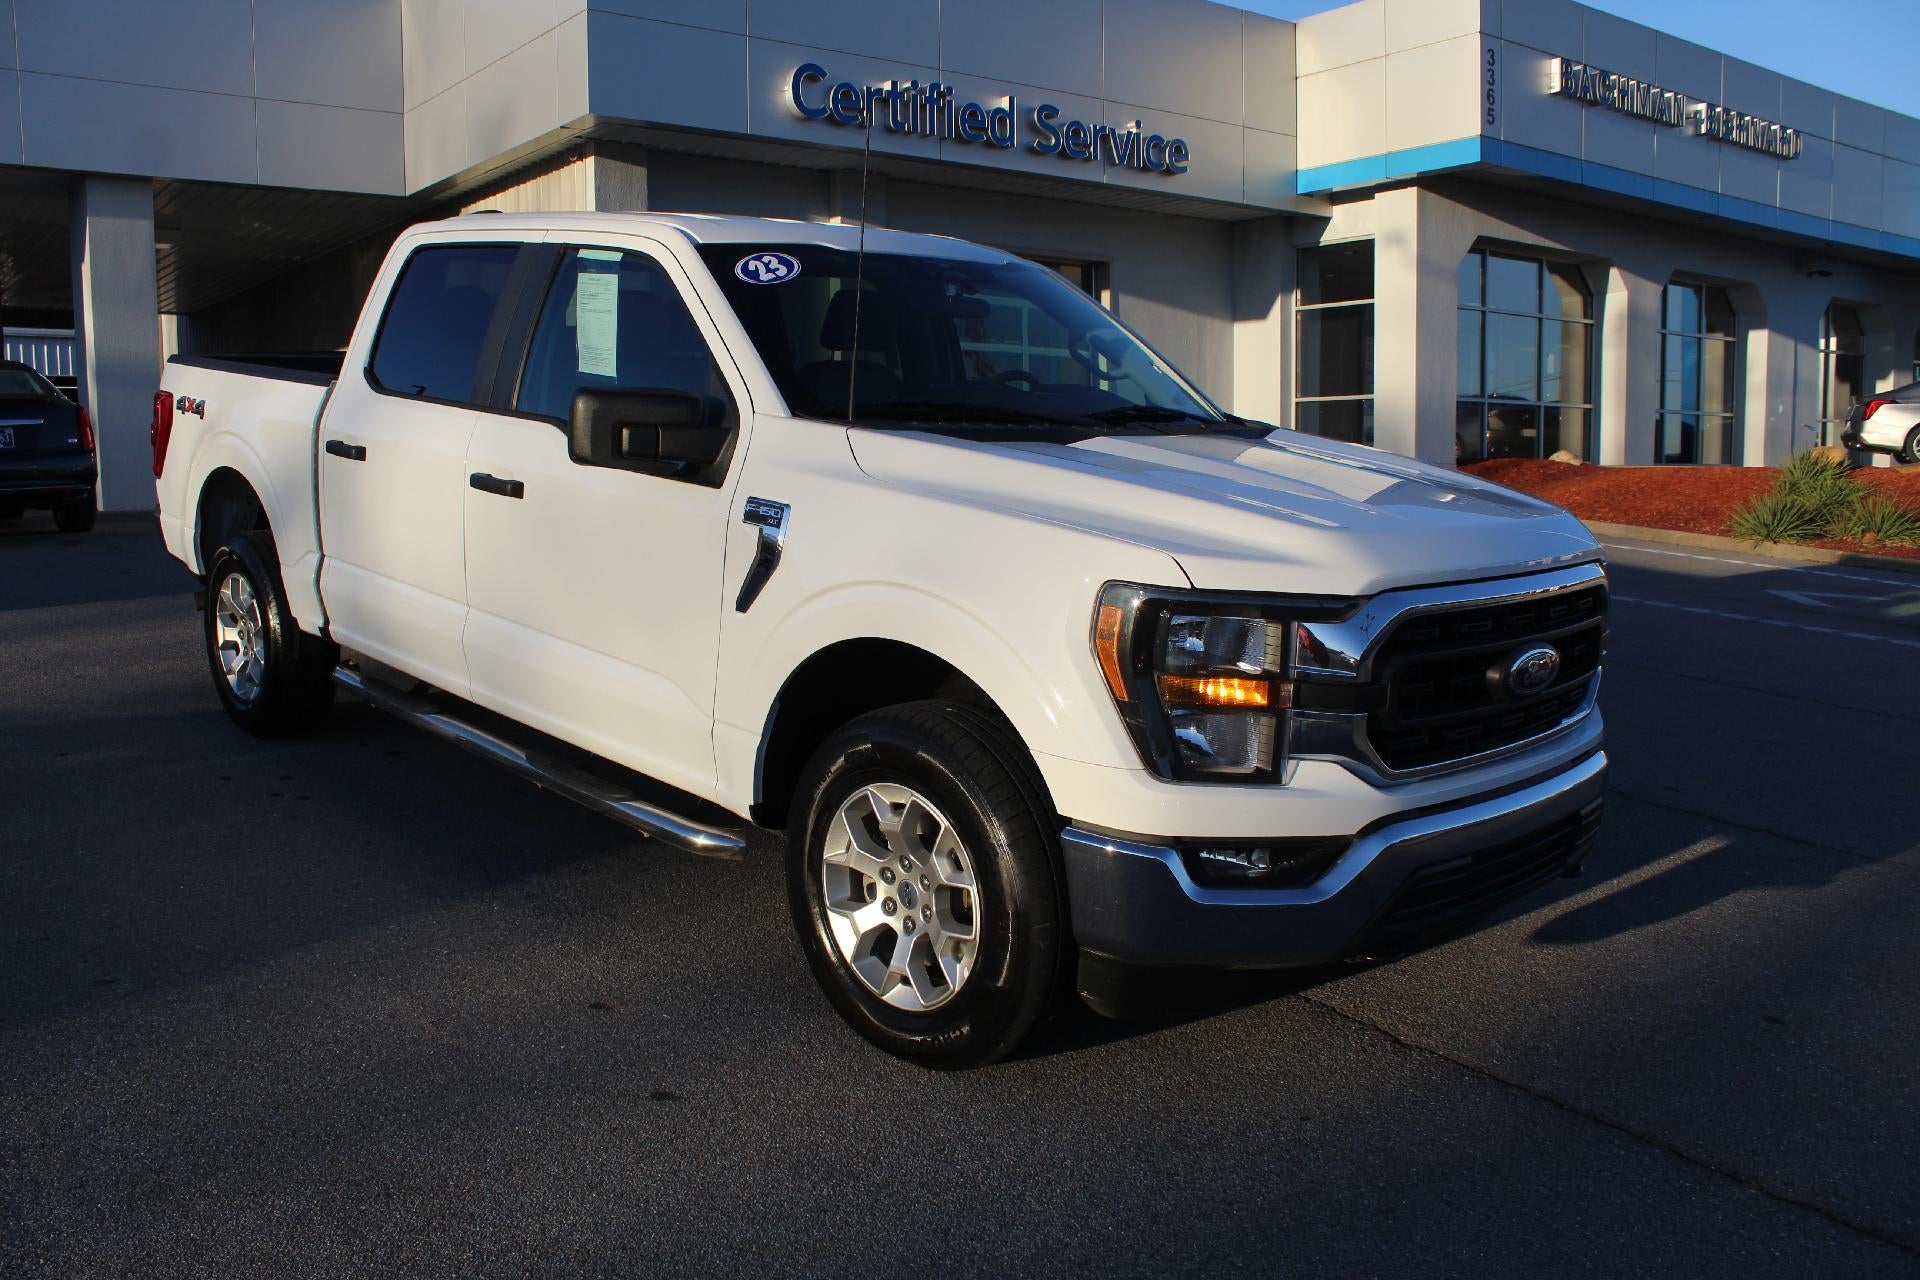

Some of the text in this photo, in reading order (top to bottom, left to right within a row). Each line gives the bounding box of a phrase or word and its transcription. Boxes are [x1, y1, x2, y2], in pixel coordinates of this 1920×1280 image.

[788, 62, 1191, 174] Certified Service
[1486, 48, 1496, 125] 3365
[1553, 56, 1687, 127] BACHMAN
[748, 255, 788, 281] 23
